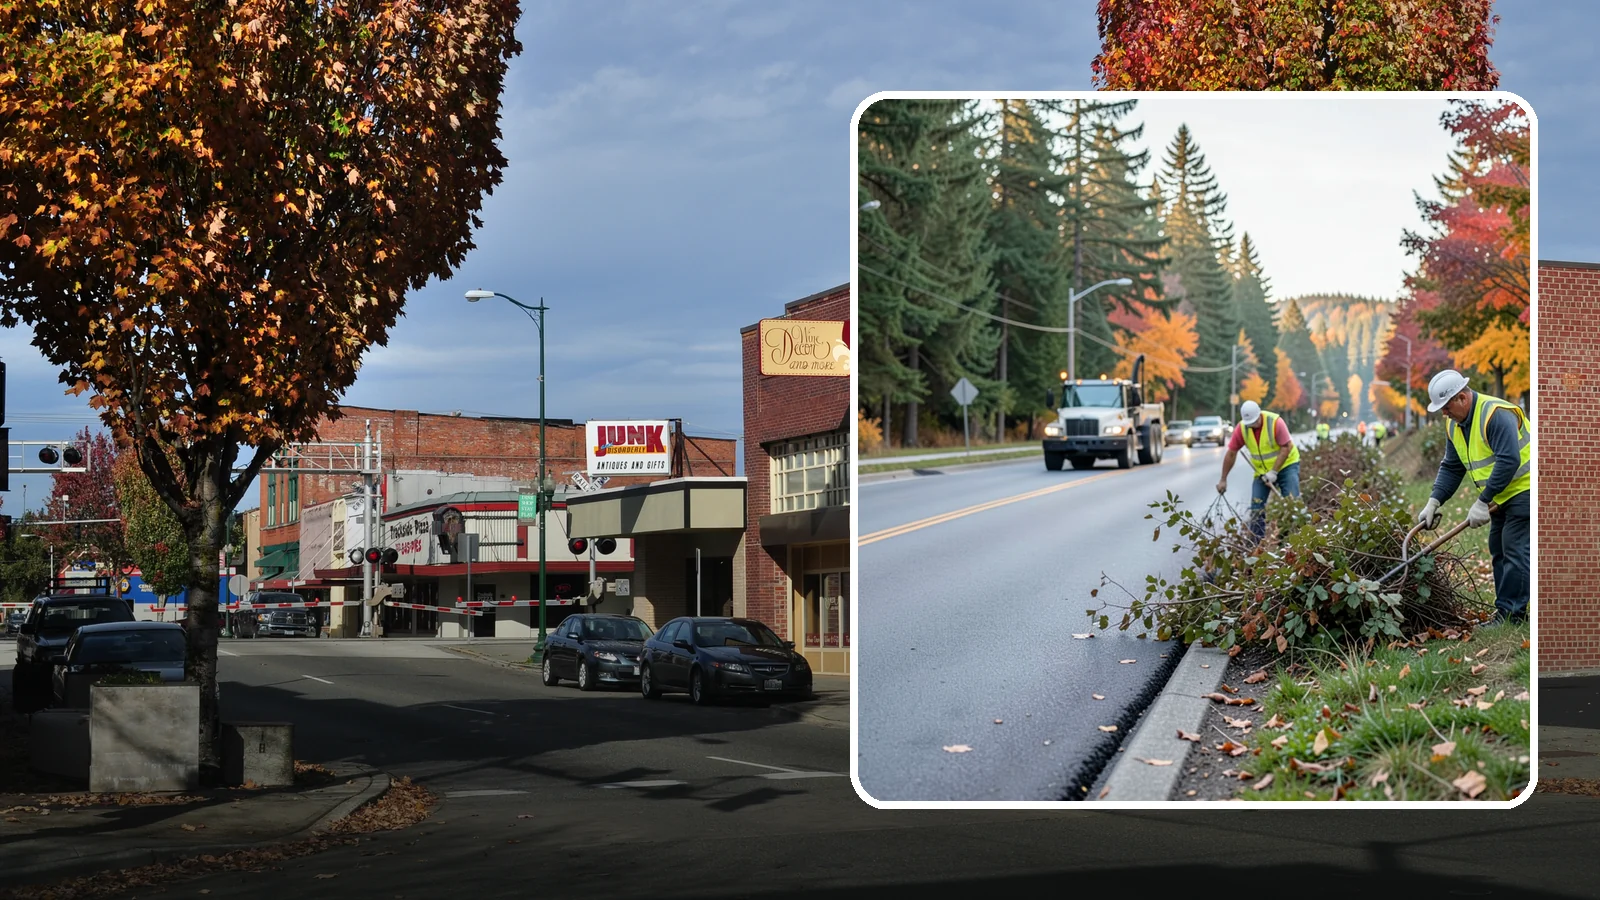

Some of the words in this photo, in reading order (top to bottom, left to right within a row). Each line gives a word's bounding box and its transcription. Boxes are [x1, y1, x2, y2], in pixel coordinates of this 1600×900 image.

[595, 425, 665, 457] JUNK
[607, 446, 646, 454] DISORDERLY
[597, 461, 628, 470] ANTIQUES
[631, 460, 644, 470] AND
[647, 460, 666, 469] GIFTS
[573, 474, 589, 493] RAIL
[390, 522, 413, 540] Trackside
[414, 519, 429, 535] Pizza
